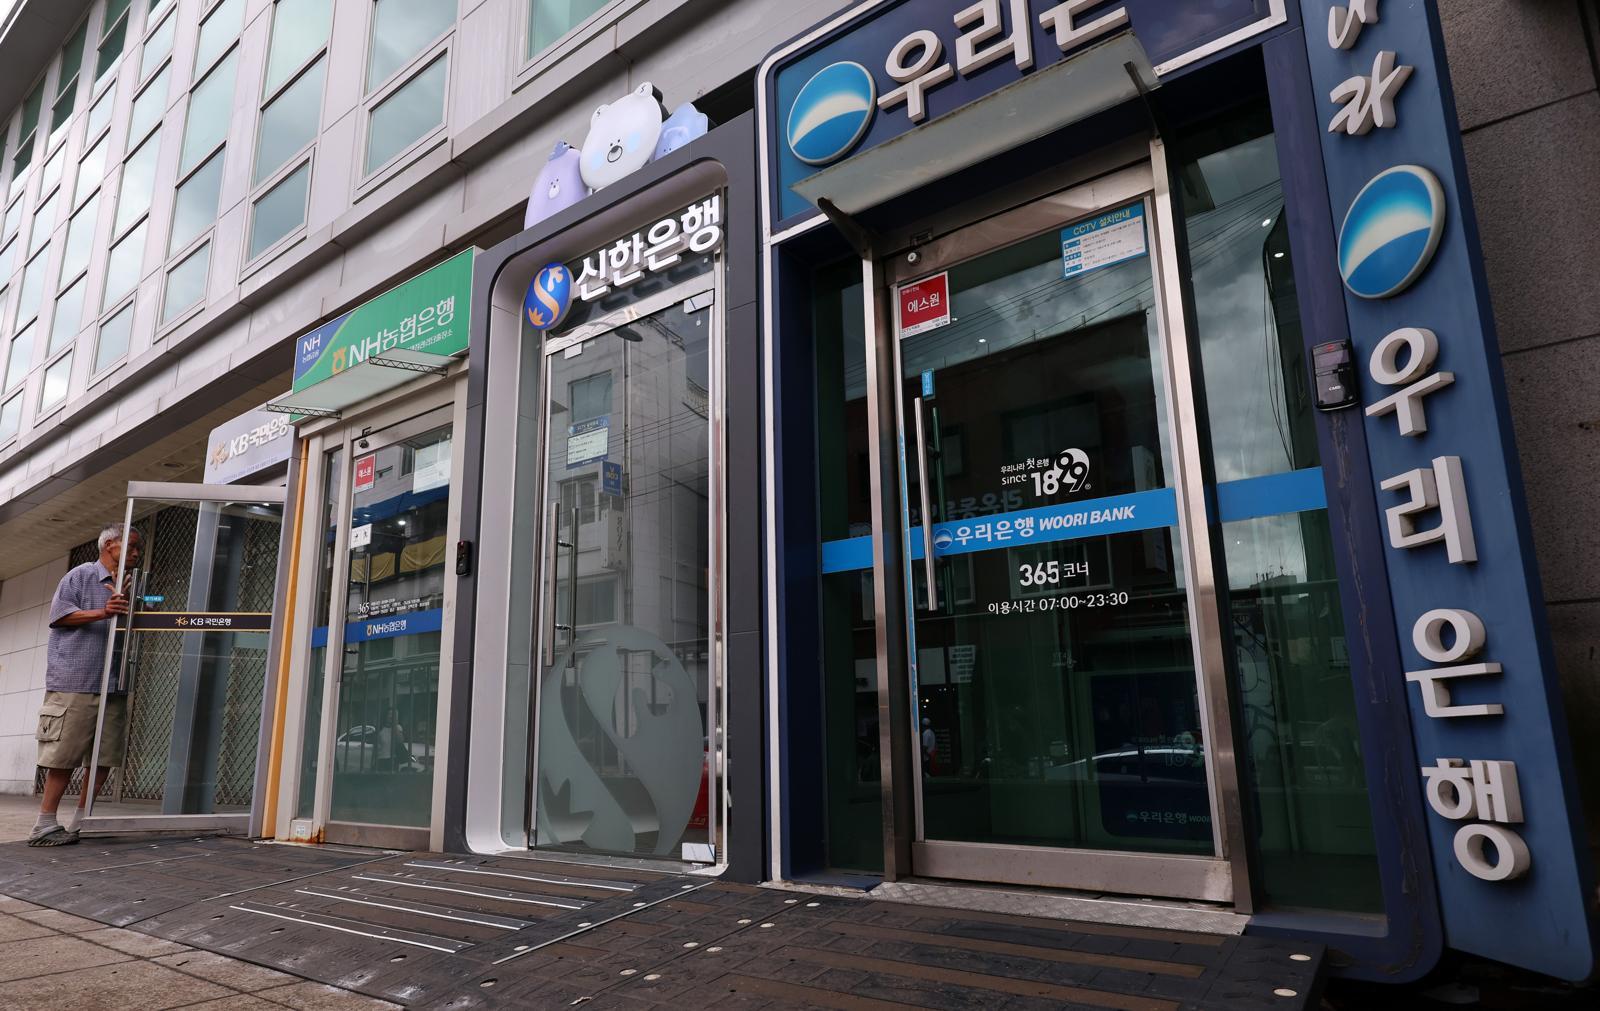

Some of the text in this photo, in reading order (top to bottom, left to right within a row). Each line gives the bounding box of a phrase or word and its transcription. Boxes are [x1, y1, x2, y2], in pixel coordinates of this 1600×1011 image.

[1073, 209, 1131, 235] CCTV 설치안내
[575, 195, 723, 302] 신한은행
[907, 292, 940, 312] 에스원
[348, 295, 455, 368] NH농협은행
[303, 334, 321, 354] NH
[1000, 458, 1049, 474] 우리나라 첫 은행
[1001, 473, 1027, 485] since
[955, 505, 1136, 546] 우리은행 WOORI BANK
[1019, 561, 1089, 586] 365 코너
[988, 591, 1129, 615] 이용시간 07:00~23:30
[1365, 327, 1531, 882] 우리은행
[372, 619, 407, 635] NH농협은행
[1139, 811, 1187, 824] 우리은행
